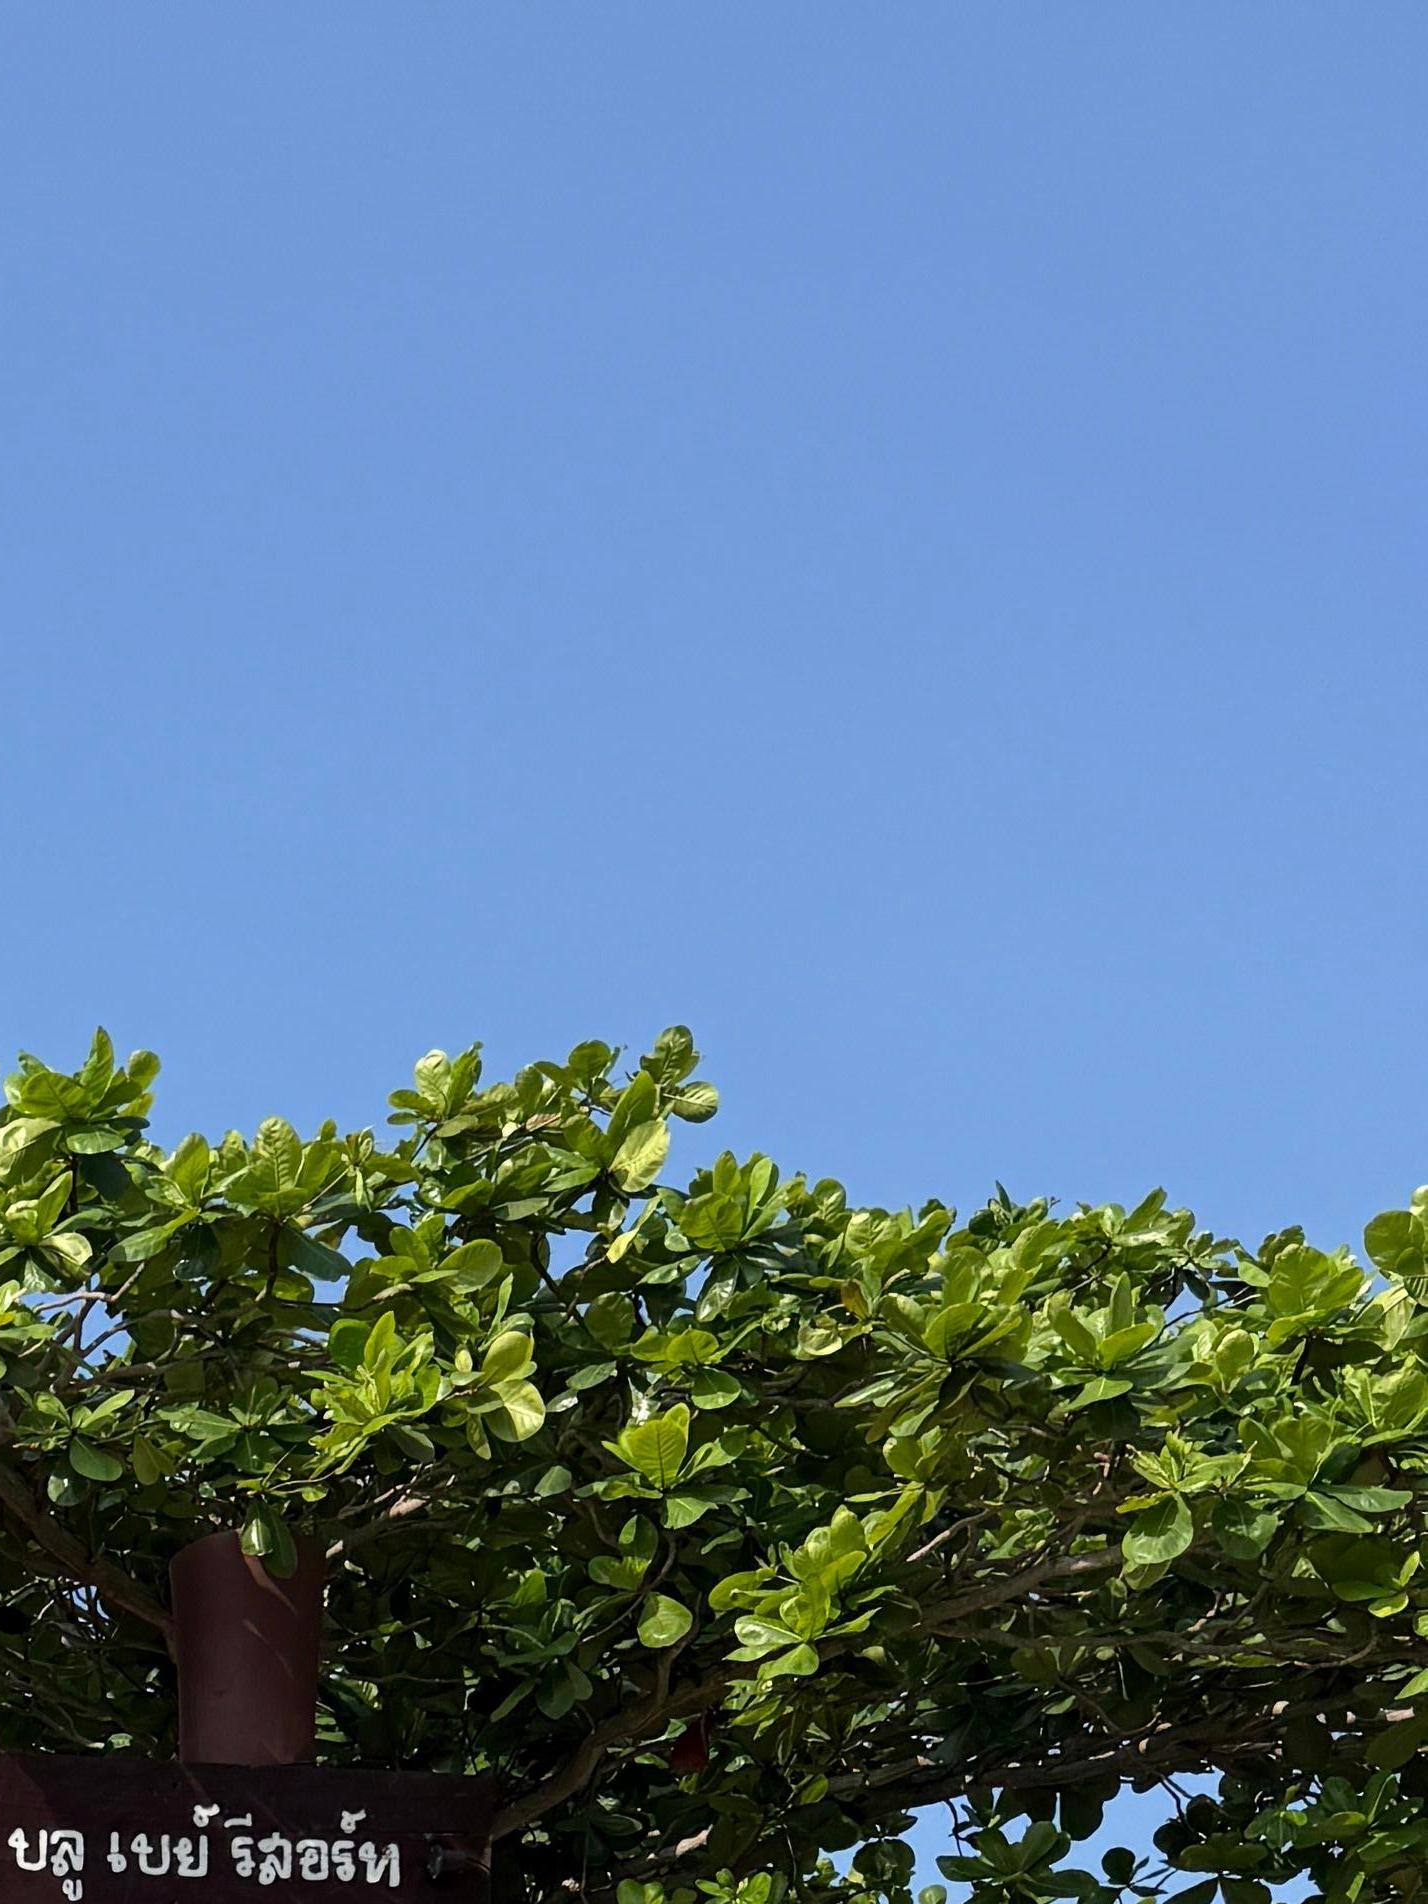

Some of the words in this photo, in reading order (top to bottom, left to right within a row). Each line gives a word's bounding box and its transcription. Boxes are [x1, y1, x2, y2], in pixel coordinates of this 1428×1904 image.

[8, 1828, 84, 1901] บลู
[107, 1804, 219, 1877] เบย์
[224, 1810, 400, 1887] รีสอร์ท
